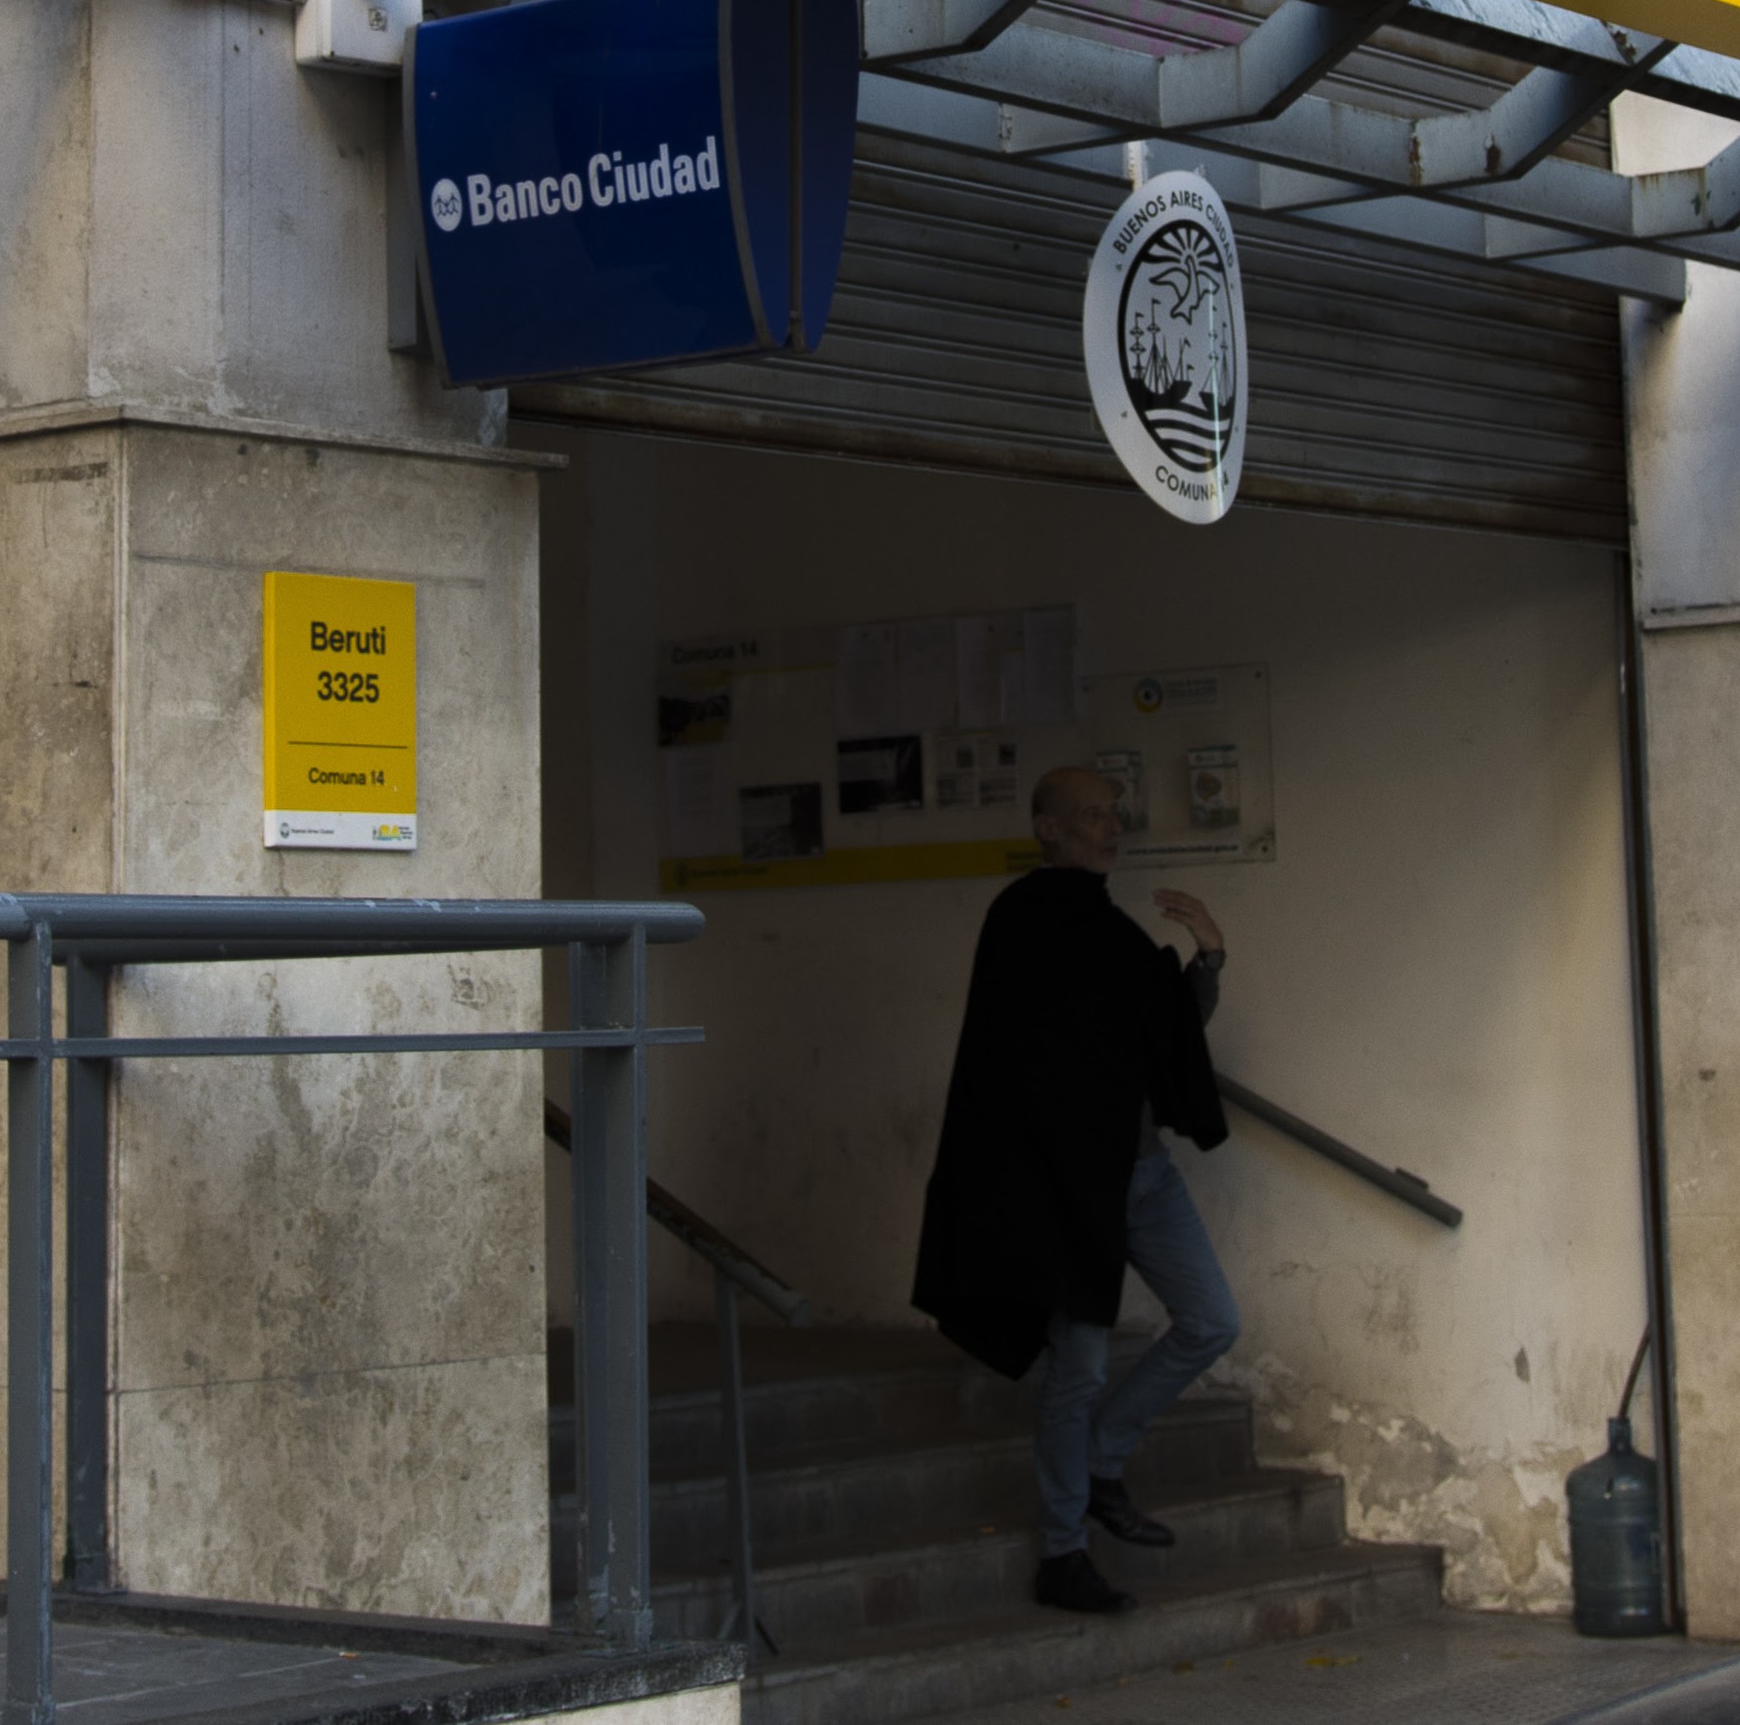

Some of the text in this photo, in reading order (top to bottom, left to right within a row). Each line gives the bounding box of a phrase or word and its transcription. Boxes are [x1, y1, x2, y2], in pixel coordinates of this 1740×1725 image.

[467, 135, 720, 227] Banco Ciudad
[1113, 190, 1234, 268] BUENOS AIRES CIUDAD
[1155, 465, 1218, 501] COMUNA
[310, 621, 386, 655] Beruti
[317, 671, 380, 703] 3325
[309, 767, 384, 786] Comuna 14
